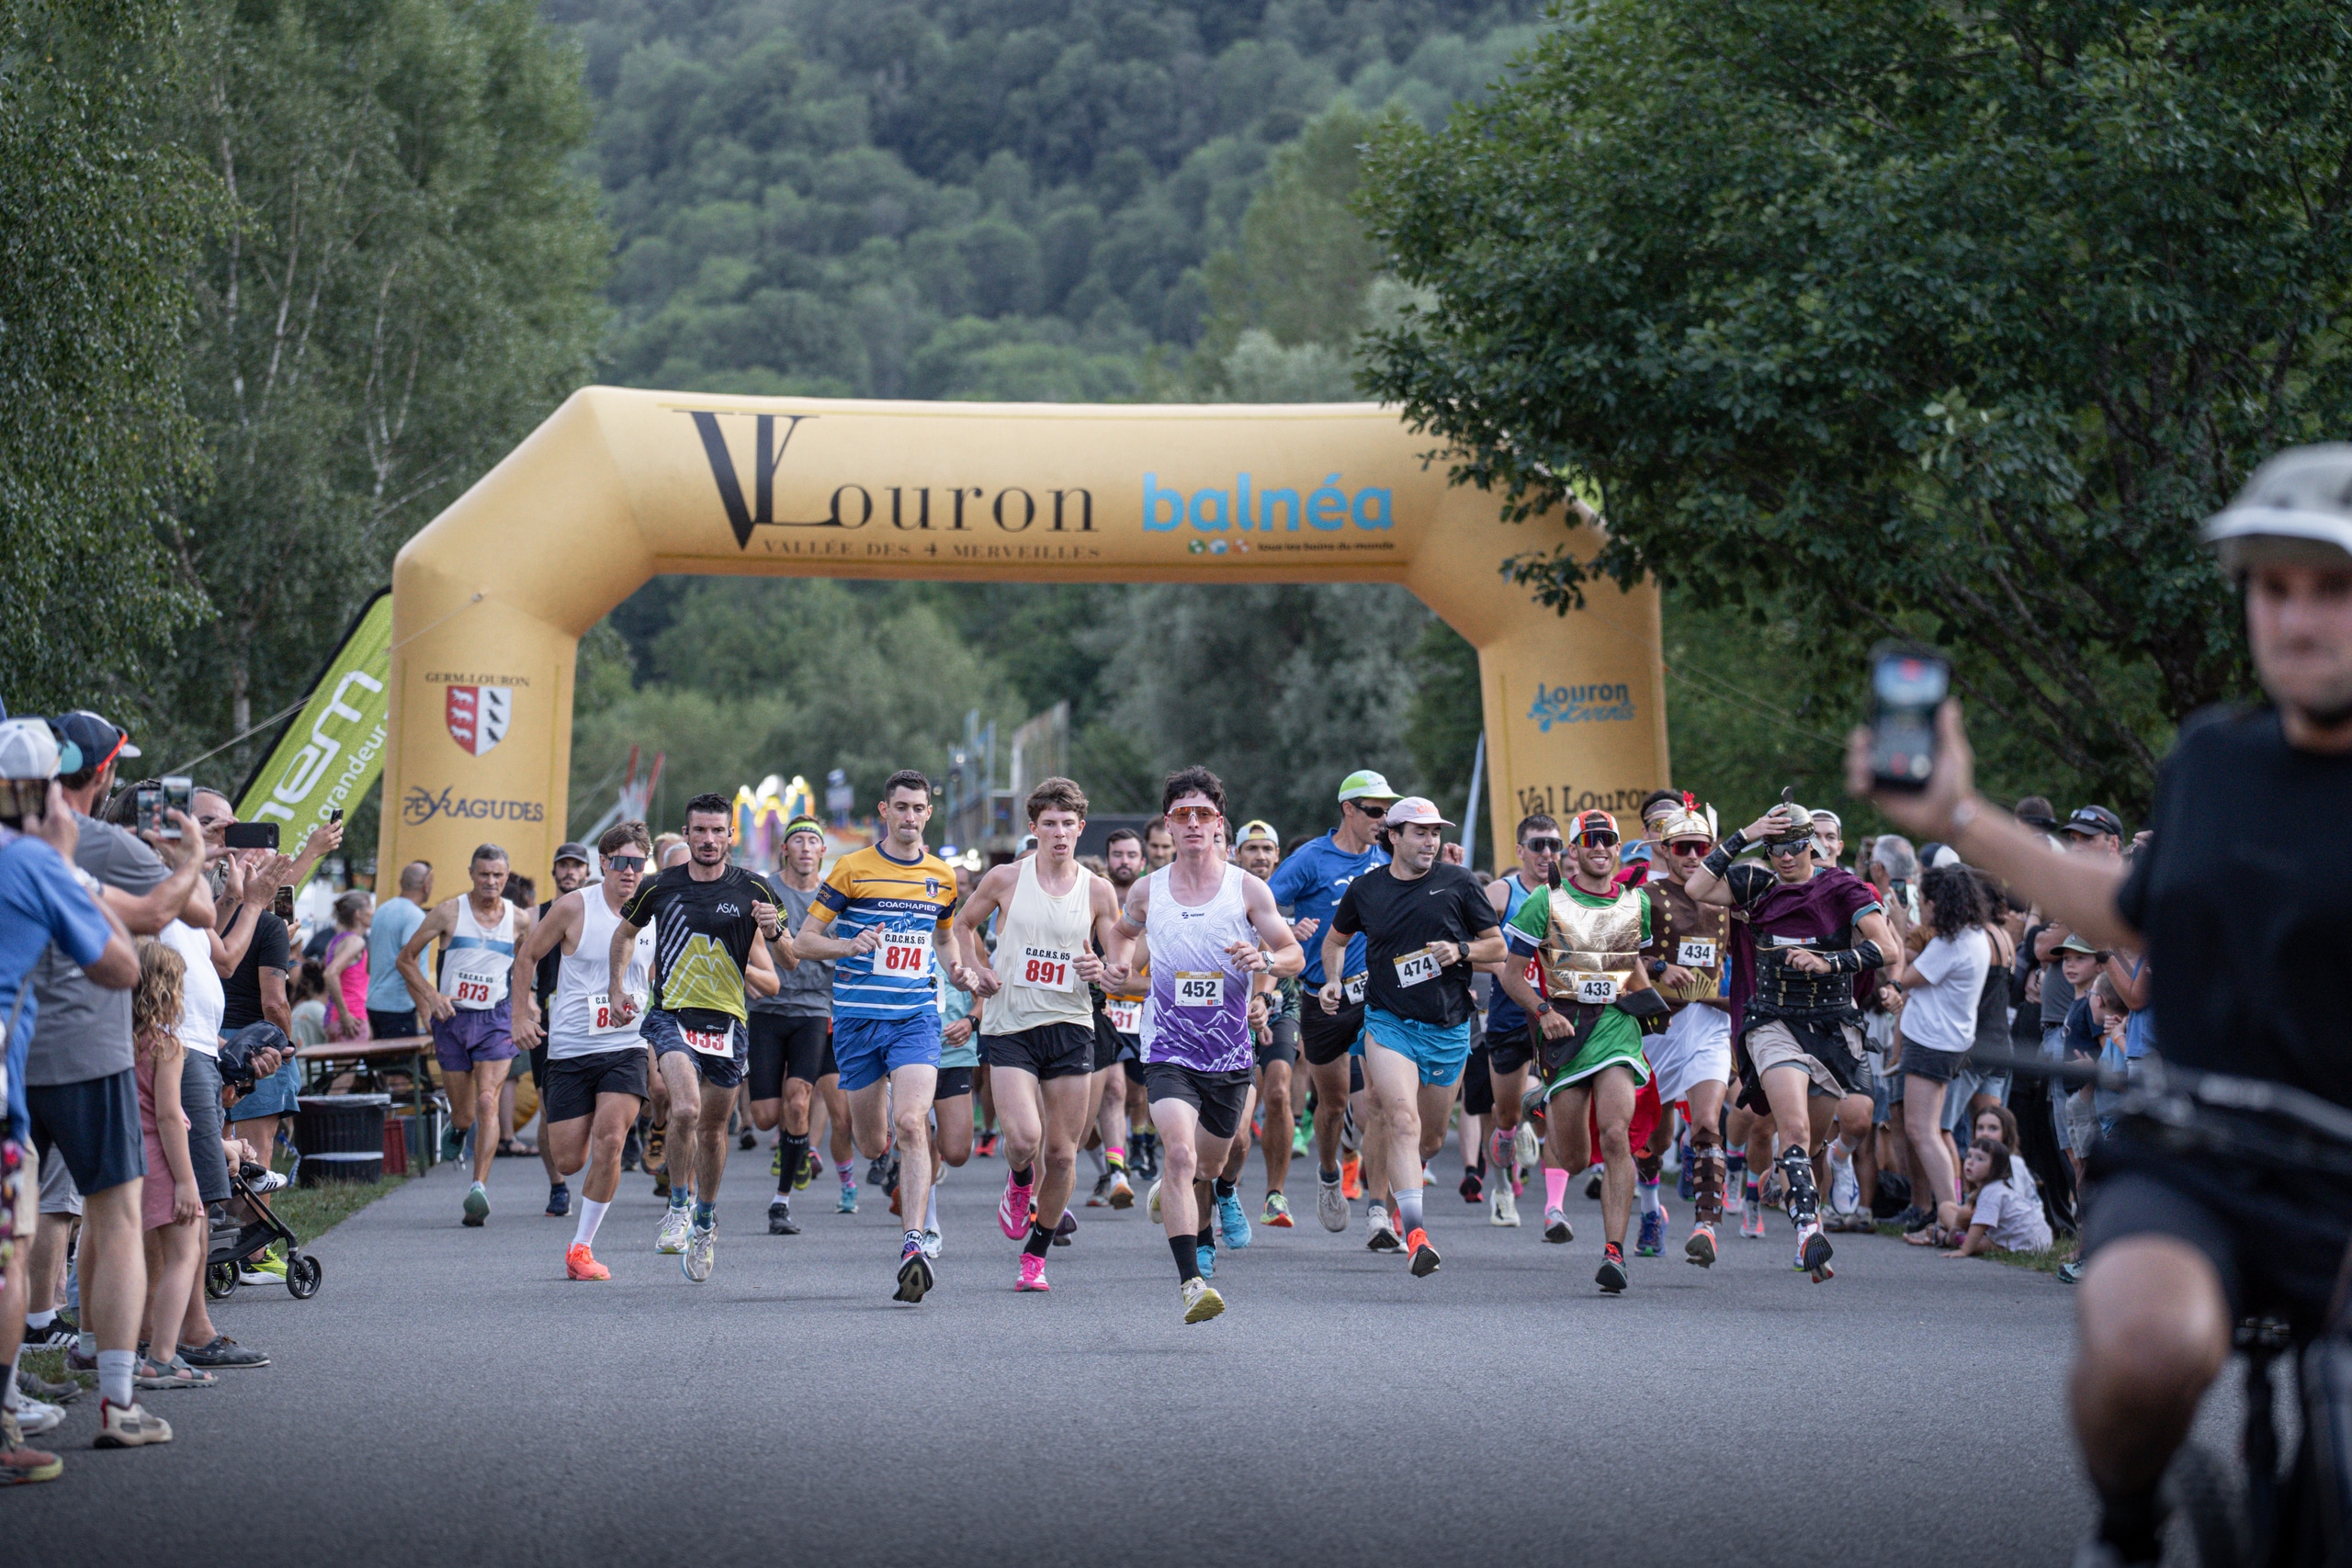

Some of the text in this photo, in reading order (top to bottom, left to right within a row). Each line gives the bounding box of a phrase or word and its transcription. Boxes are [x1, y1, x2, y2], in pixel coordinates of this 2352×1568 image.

[1142, 472, 1394, 532] balnéa
[763, 538, 1101, 559] VALLÉE DES 4 MERVEILLES
[425, 672, 530, 687] GERM-LOURON
[1538, 682, 1629, 705] Louron
[402, 784, 544, 826] PEYRAGUDES
[1518, 785, 1554, 815] Val
[716, 903, 741, 918] ASM
[877, 901, 936, 912] COACHAPIED
[917, 936, 925, 944] 65
[886, 946, 922, 971] 874
[1060, 952, 1070, 961] 65
[1684, 944, 1710, 960] 434
[1025, 959, 1065, 986] 891
[1404, 956, 1432, 976] 474
[458, 981, 489, 1002] 873
[1182, 981, 1216, 998] 452
[1584, 982, 1611, 997] 433
[685, 1029, 725, 1051] 833
